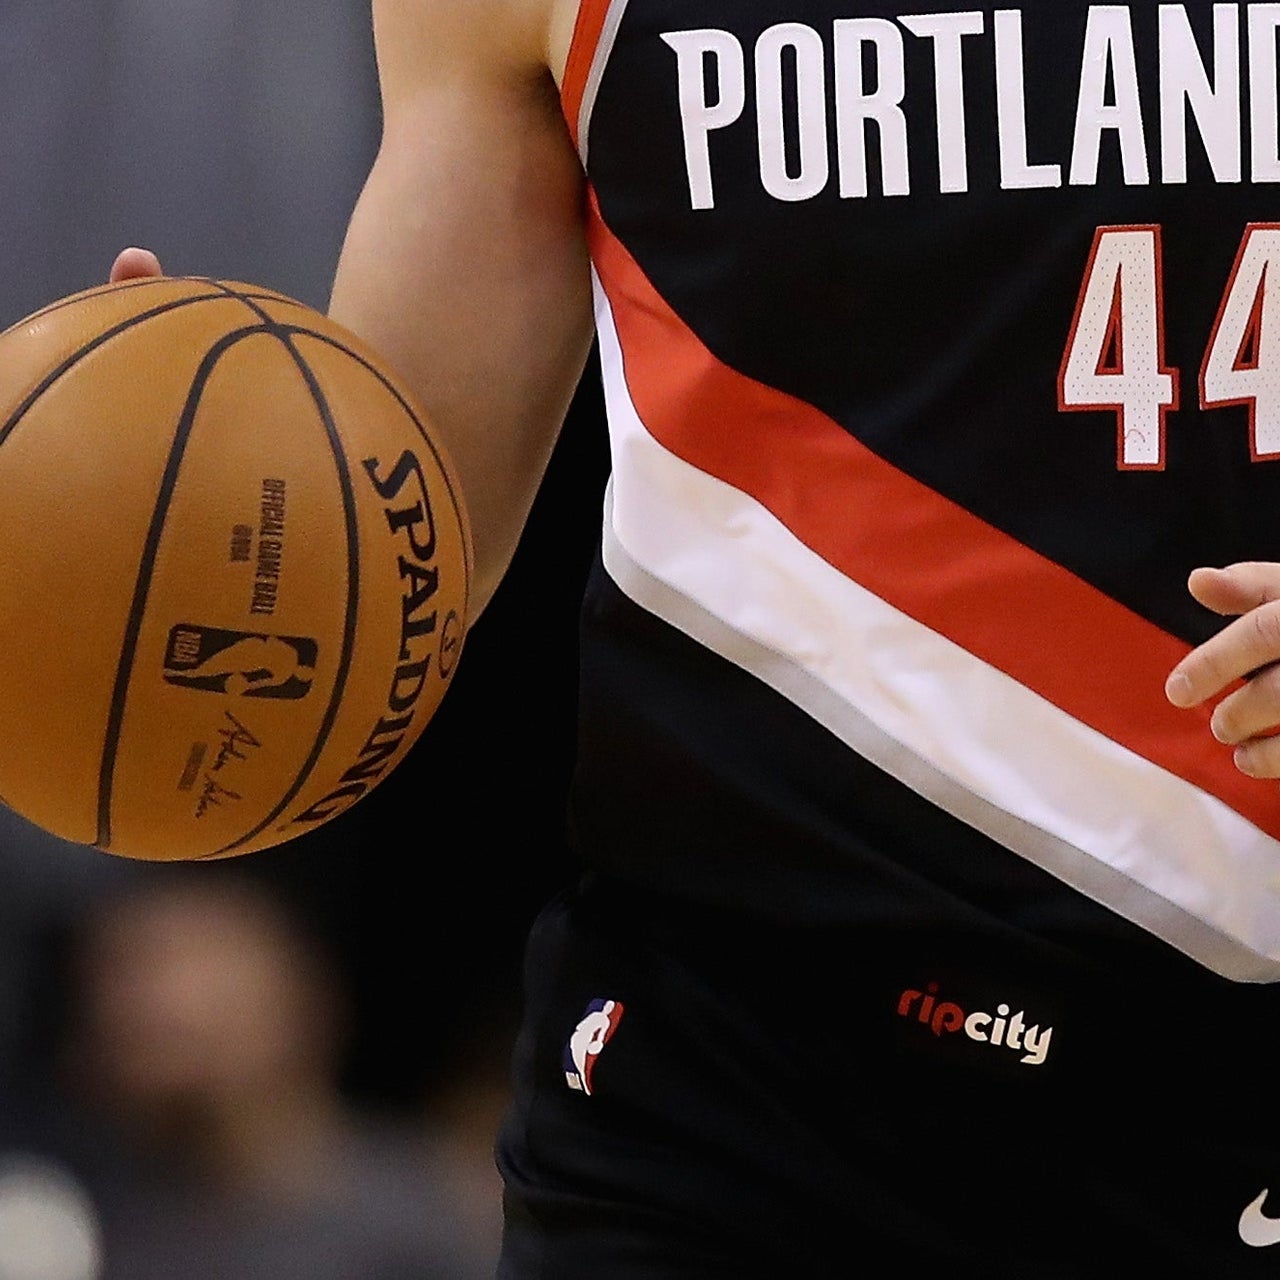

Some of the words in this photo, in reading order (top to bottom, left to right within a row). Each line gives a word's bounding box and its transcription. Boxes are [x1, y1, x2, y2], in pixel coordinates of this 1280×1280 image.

[259, 478, 286, 536] OFFICIAL
[256, 540, 284, 581] GAME
[250, 582, 279, 615] BALL
[292, 449, 440, 823] SPALDING
